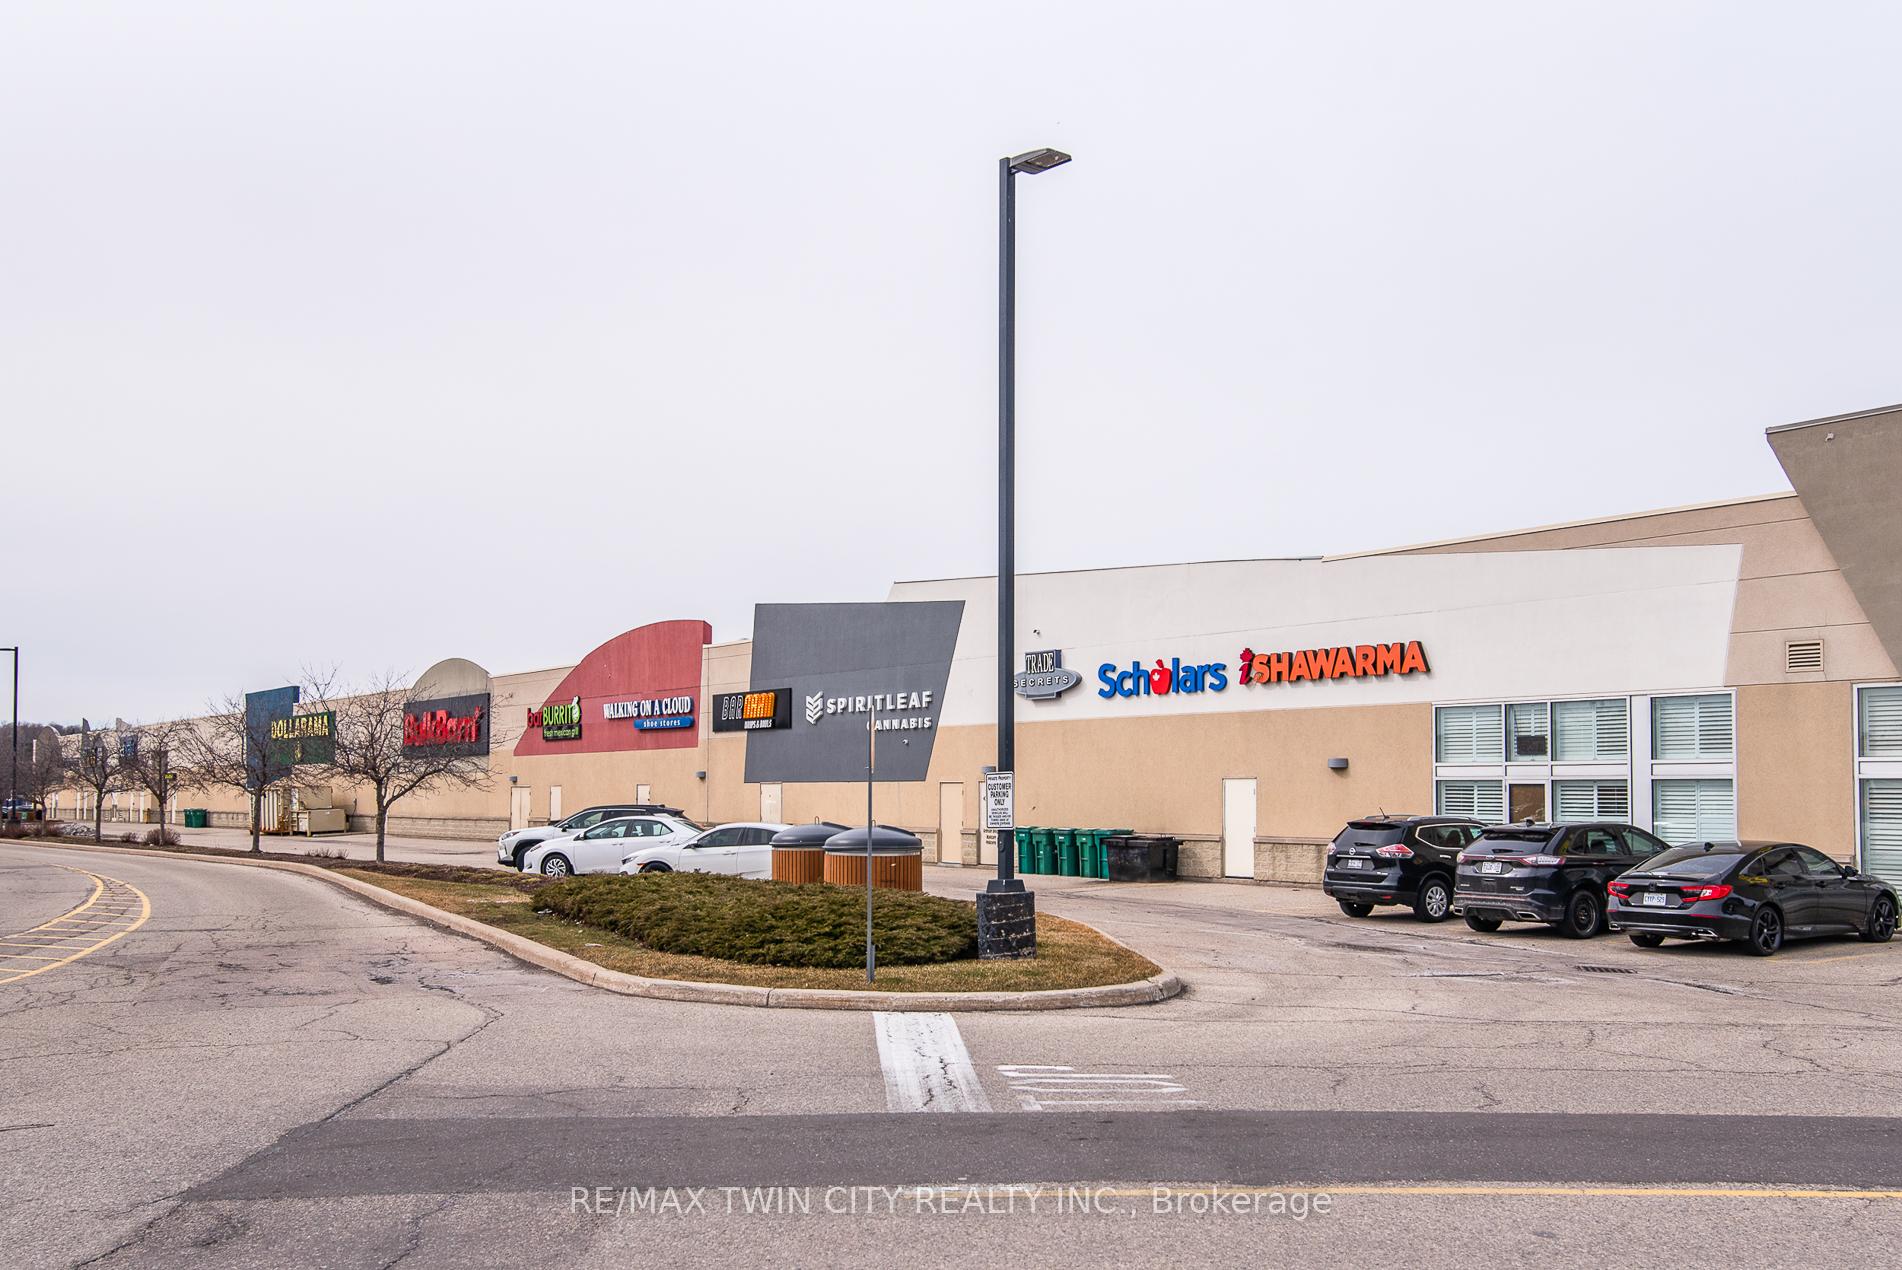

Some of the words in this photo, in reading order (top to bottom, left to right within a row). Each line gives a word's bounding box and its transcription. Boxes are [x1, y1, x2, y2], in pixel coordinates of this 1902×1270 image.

[1026, 653, 1054, 674] TRADE
[1014, 675, 1069, 688] SECRETS
[1098, 657, 1228, 699] Scholars
[603, 701, 638, 719] WALKING
[640, 699, 652, 717] ON
[654, 699, 661, 716] A
[662, 696, 691, 715] CLOUD
[826, 691, 932, 714] SPIRITLEAF
[271, 715, 329, 739] DOLLARAMA
[644, 719, 658, 728] shoe
[660, 719, 680, 727] stores
[988, 782, 1011, 791] CUSTOMER
[990, 790, 1009, 798] PARKING
[994, 798, 1005, 806] ONLY
